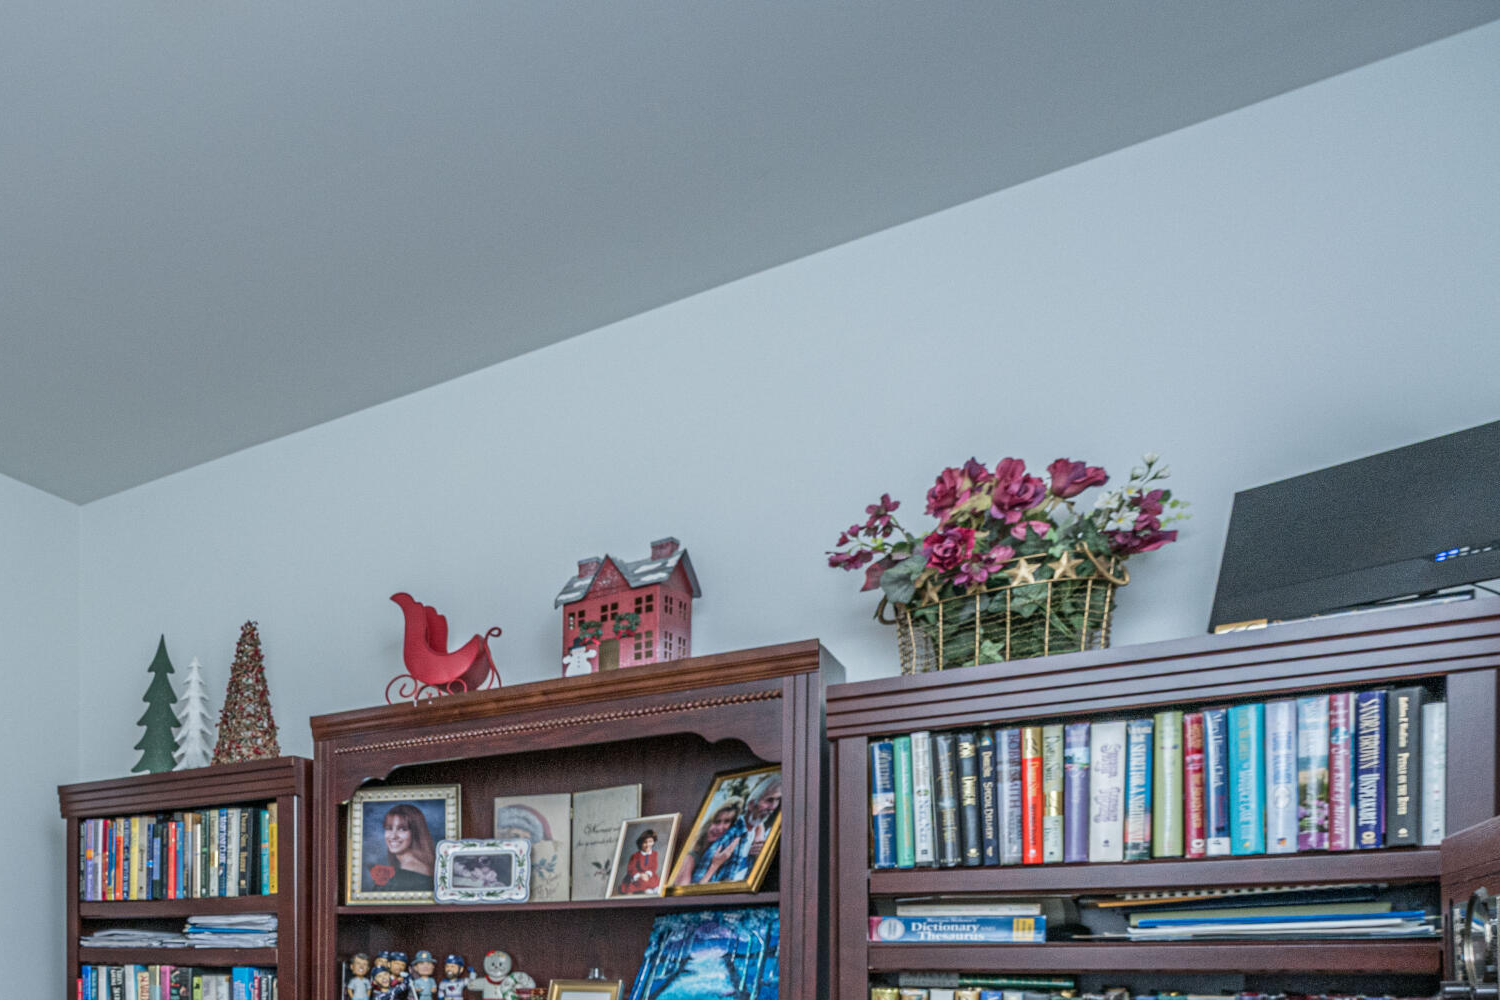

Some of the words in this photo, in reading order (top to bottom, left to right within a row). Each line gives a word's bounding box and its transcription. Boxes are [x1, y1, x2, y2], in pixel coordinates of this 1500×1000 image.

[1359, 698, 1380, 733] SANDRA
[1359, 734, 1380, 769] BROWN
[1359, 773, 1380, 827] UNSPEAKABLE
[911, 922, 980, 933] Dictionary
[917, 931, 985, 941] Thesaurus
